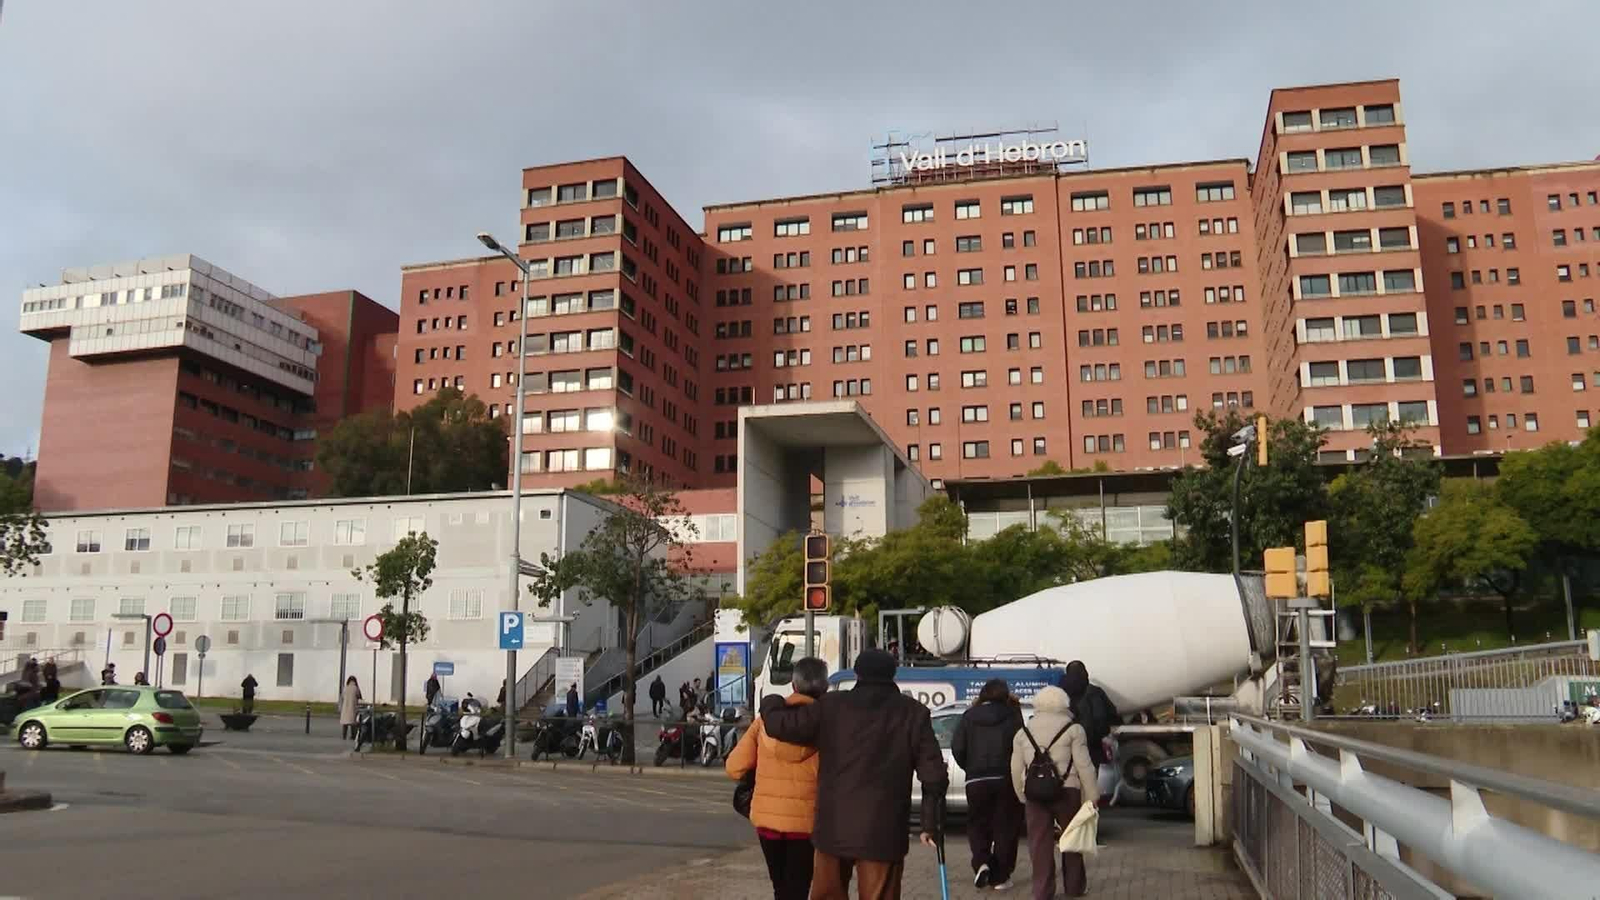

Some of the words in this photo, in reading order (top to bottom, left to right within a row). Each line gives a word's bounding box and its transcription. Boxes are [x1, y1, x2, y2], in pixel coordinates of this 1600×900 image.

[900, 146, 946, 171] Vall
[956, 139, 1085, 167] d'Hebron
[503, 614, 519, 635] P
